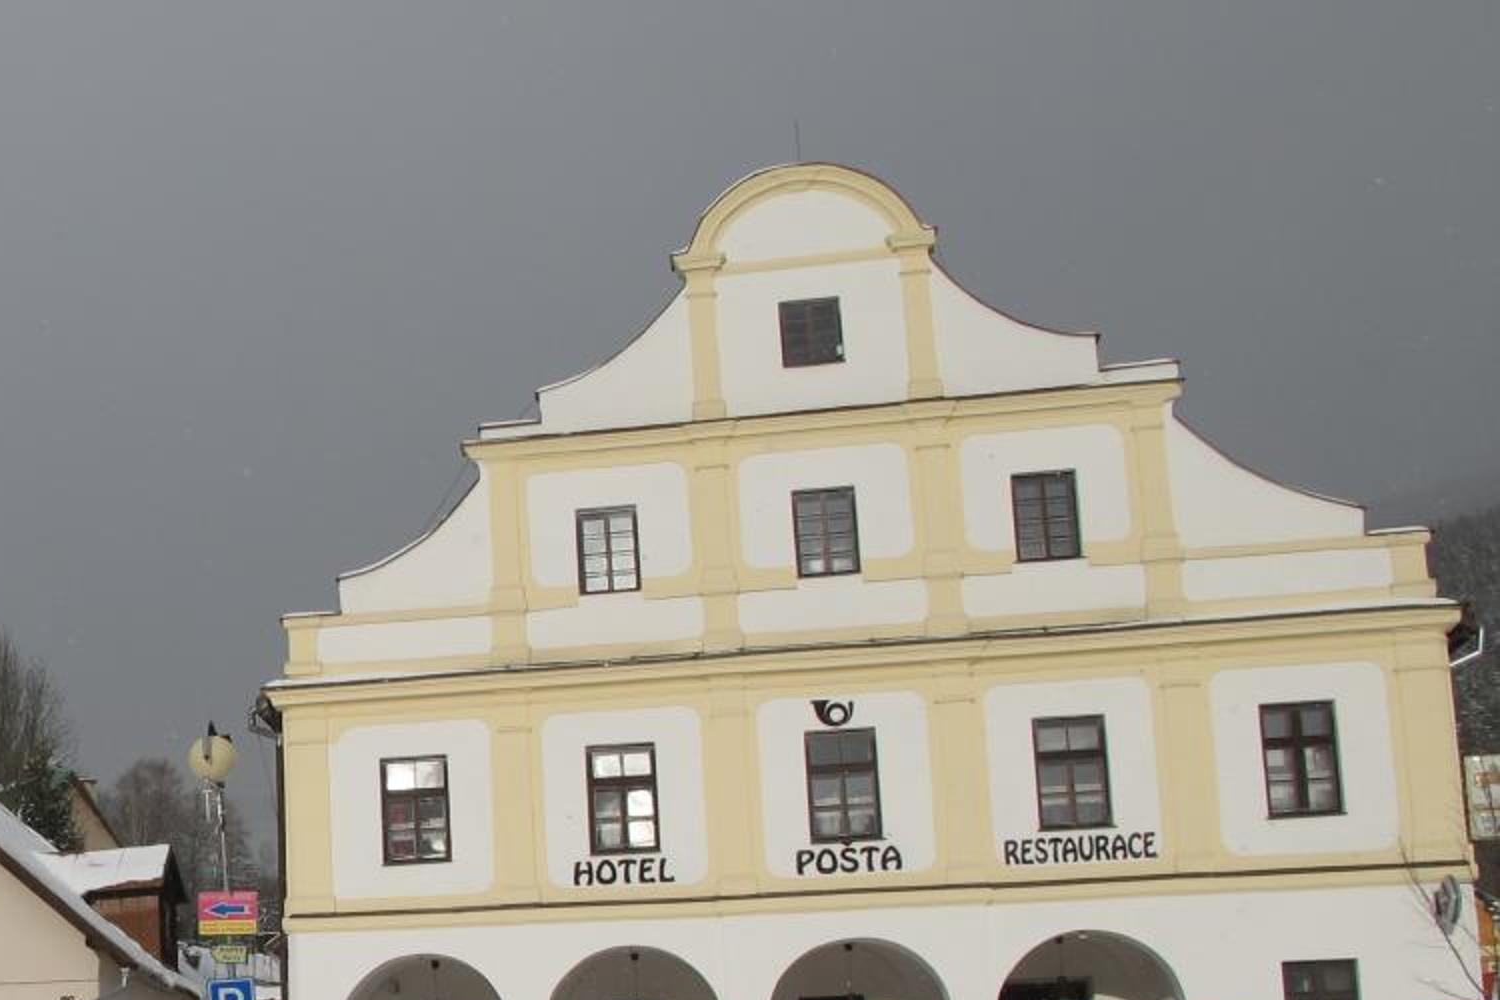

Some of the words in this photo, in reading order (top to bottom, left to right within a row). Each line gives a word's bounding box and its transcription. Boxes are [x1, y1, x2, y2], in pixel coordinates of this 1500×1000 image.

[796, 841, 902, 875] POŠTA
[1004, 832, 1158, 865] RESTAURACE
[573, 857, 676, 886] HOTEL
